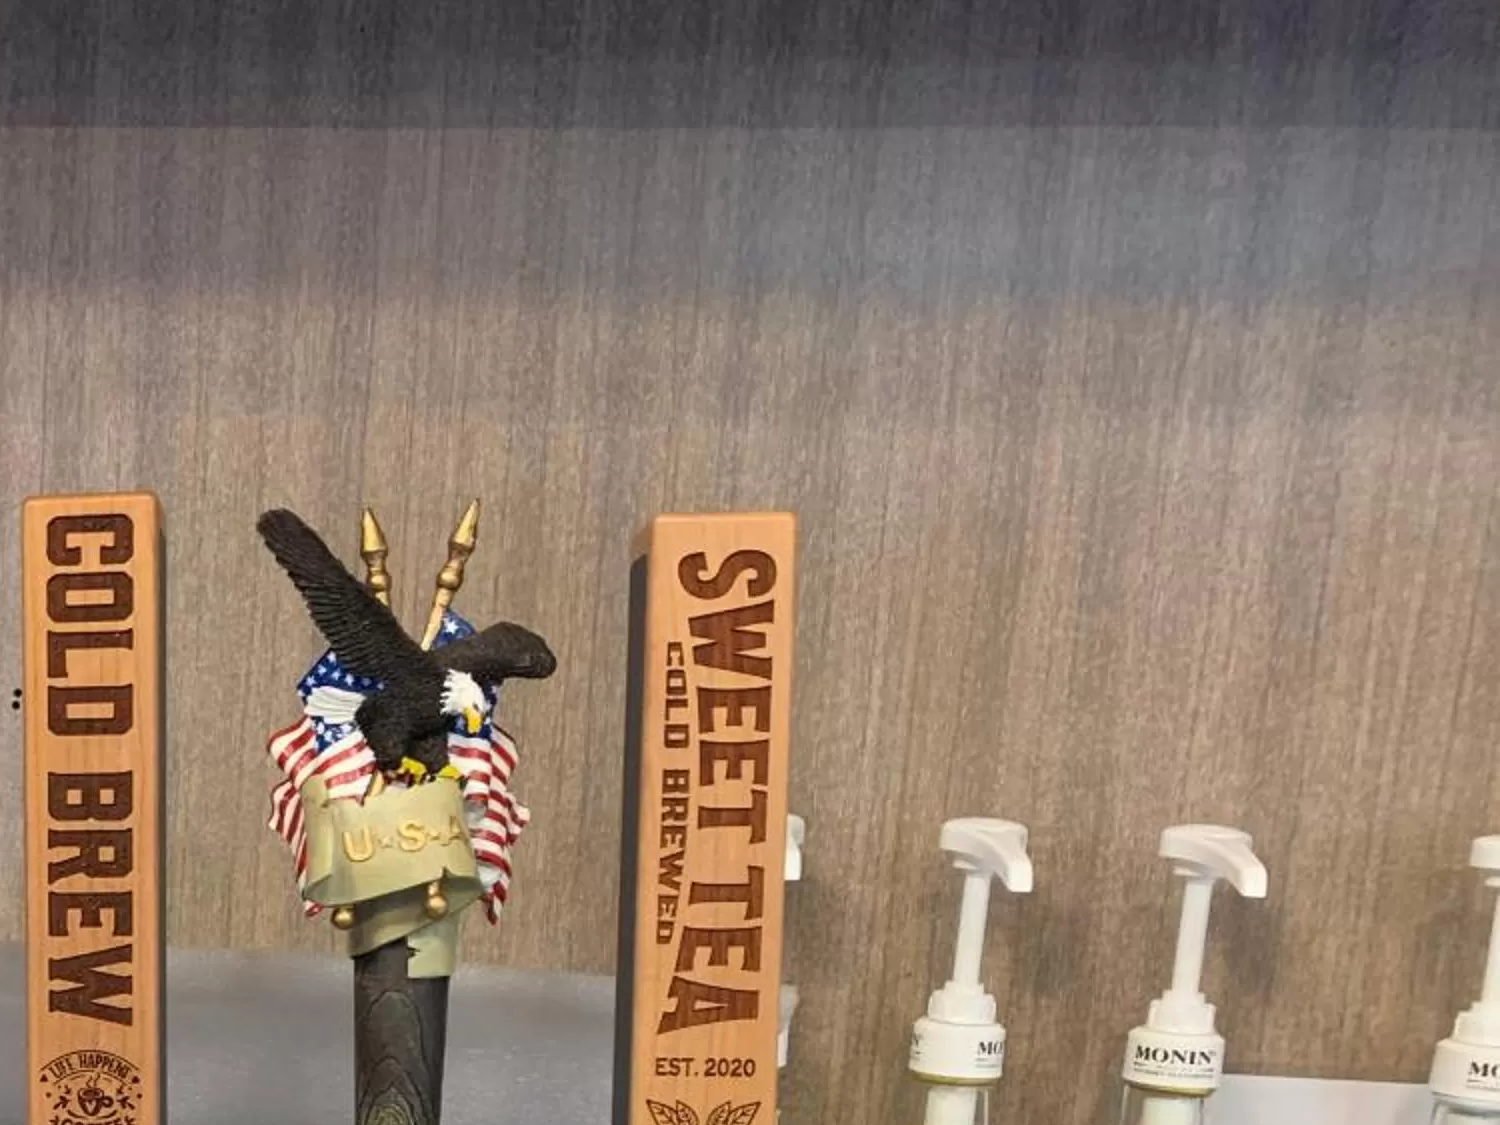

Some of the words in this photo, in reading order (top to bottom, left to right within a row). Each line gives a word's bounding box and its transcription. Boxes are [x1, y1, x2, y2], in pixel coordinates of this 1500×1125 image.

[47, 514, 134, 736] COLD
[665, 641, 690, 748] COLD
[677, 549, 777, 844] SWEET
[47, 770, 133, 1027] BREW
[656, 769, 690, 945] BREWED
[657, 866, 765, 1035] TEA
[655, 1057, 699, 1077] EST.
[704, 1058, 756, 1078] 2020
[1135, 1045, 1213, 1065] MONIN
